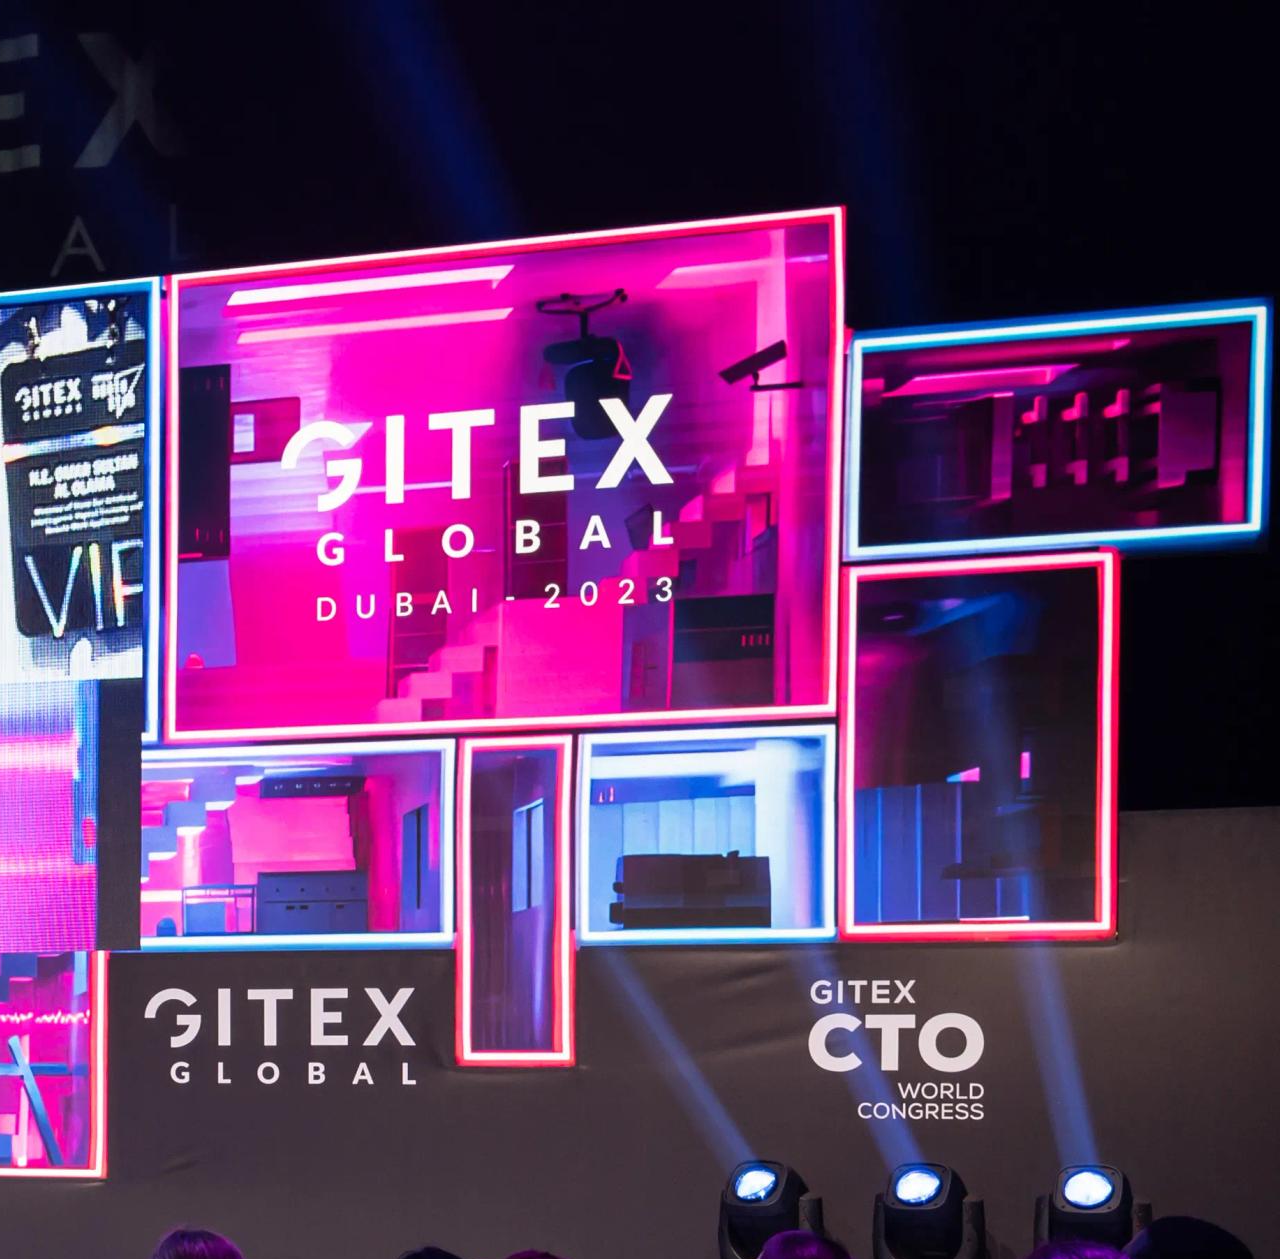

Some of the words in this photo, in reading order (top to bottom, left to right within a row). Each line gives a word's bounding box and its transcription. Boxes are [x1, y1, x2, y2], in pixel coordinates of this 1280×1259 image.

[15, 377, 82, 411] GITEX
[281, 393, 674, 512] GITEX
[316, 511, 674, 566] GLOBAL
[810, 979, 916, 1005] GITEX
[144, 988, 417, 1048] GITEX
[808, 1012, 985, 1073] CTO
[170, 1061, 417, 1085] GLOBAL
[897, 1082, 985, 1100] WORLD
[857, 1102, 985, 1120] CONGRESS
